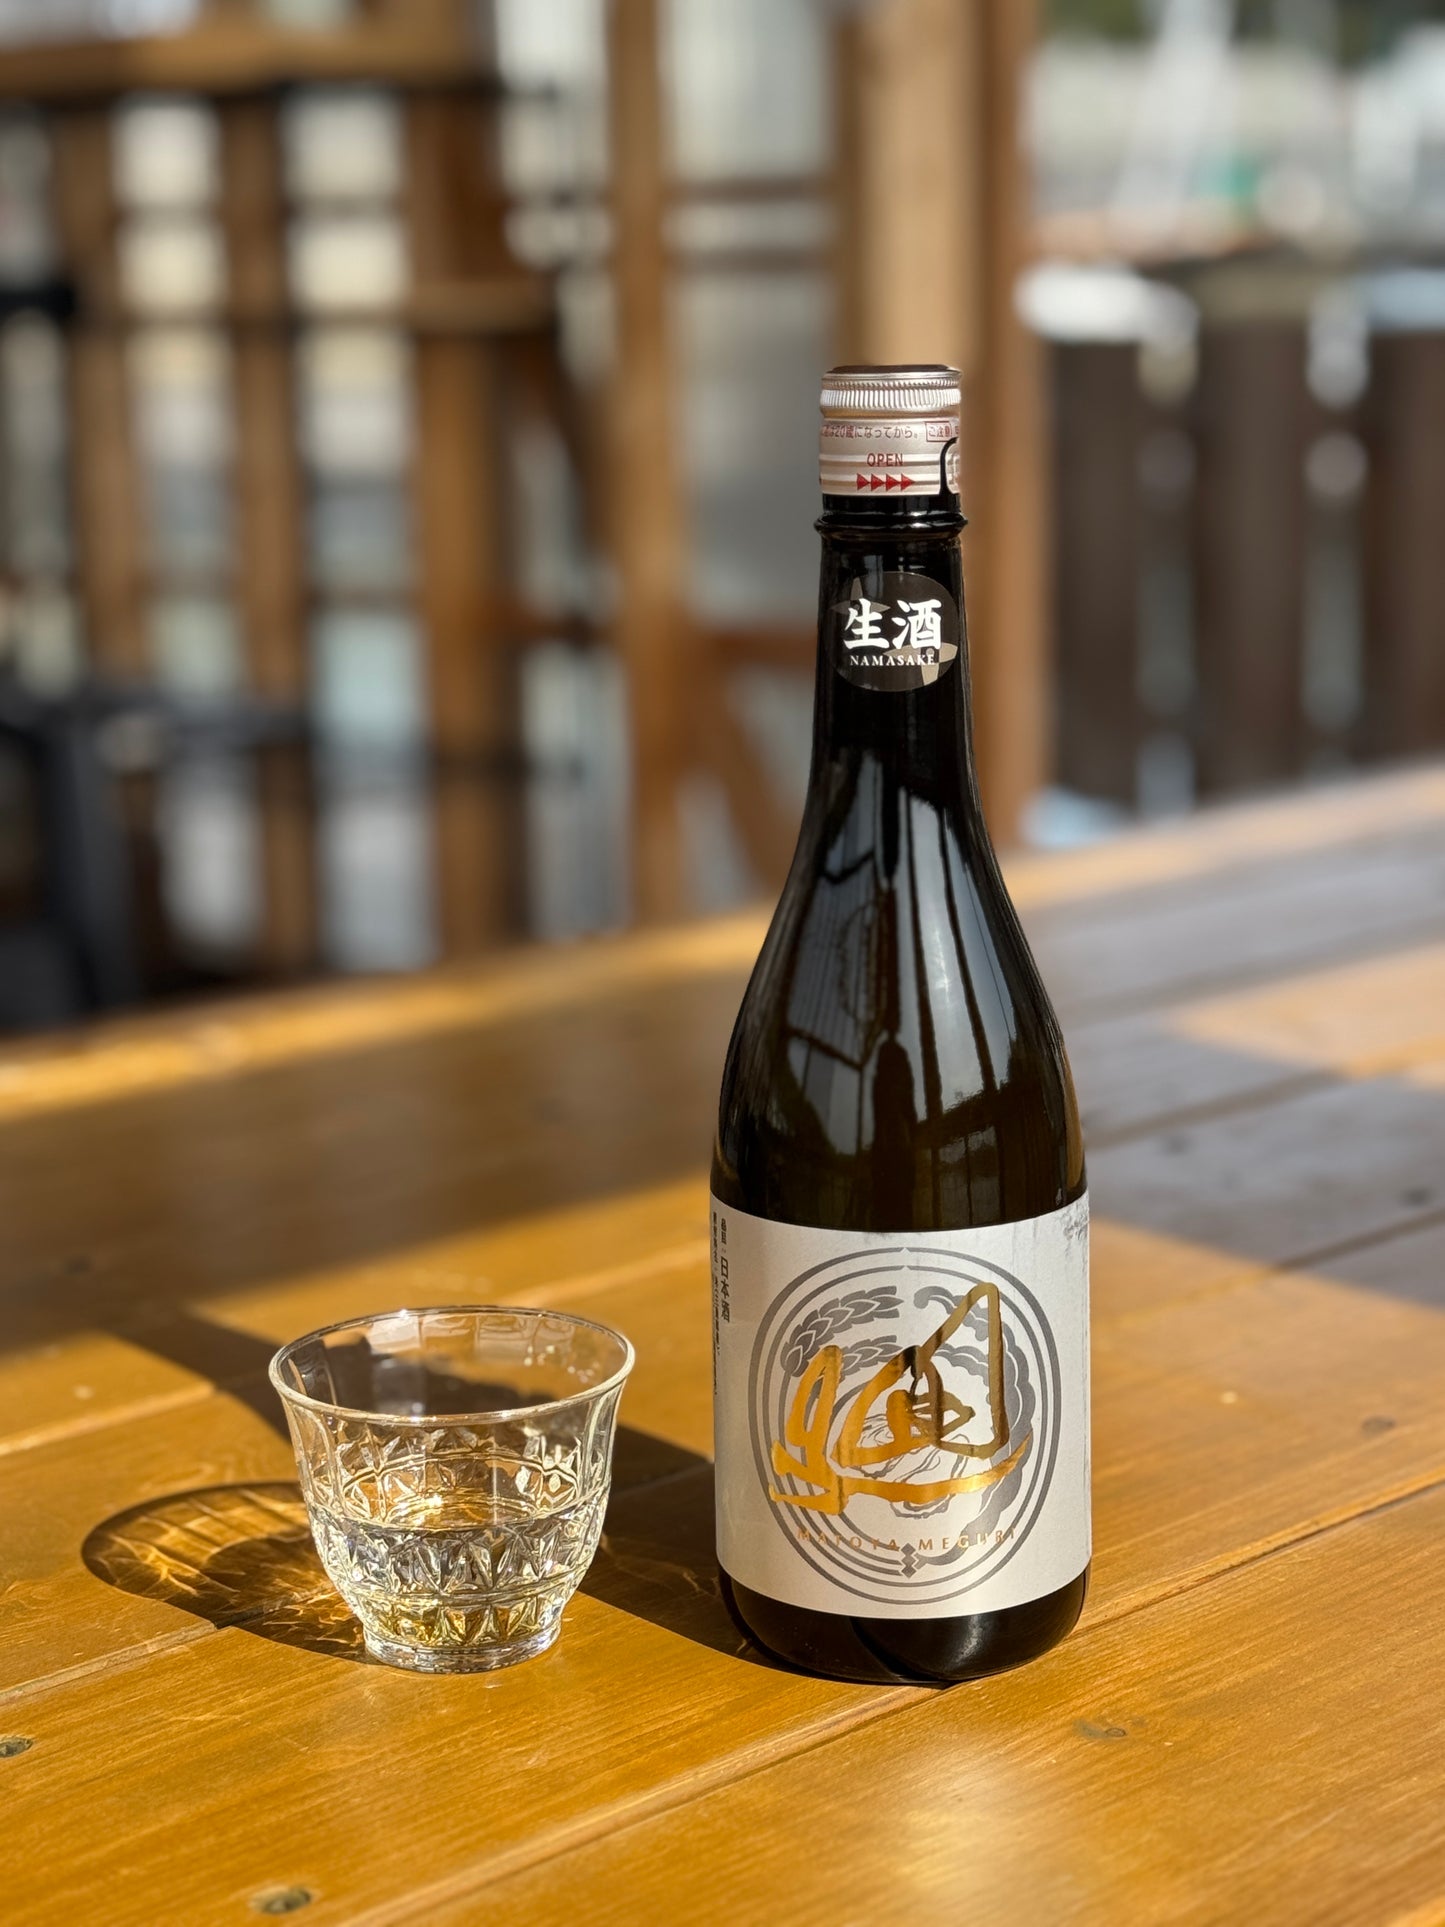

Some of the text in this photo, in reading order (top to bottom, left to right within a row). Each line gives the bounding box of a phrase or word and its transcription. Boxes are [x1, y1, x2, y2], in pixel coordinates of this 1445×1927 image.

[866, 452, 904, 467] OPEN
[843, 598, 942, 649] 生酒
[850, 654, 936, 666] NAMASAKE
[797, 1526, 1015, 1550] MATOYA MEGURI
